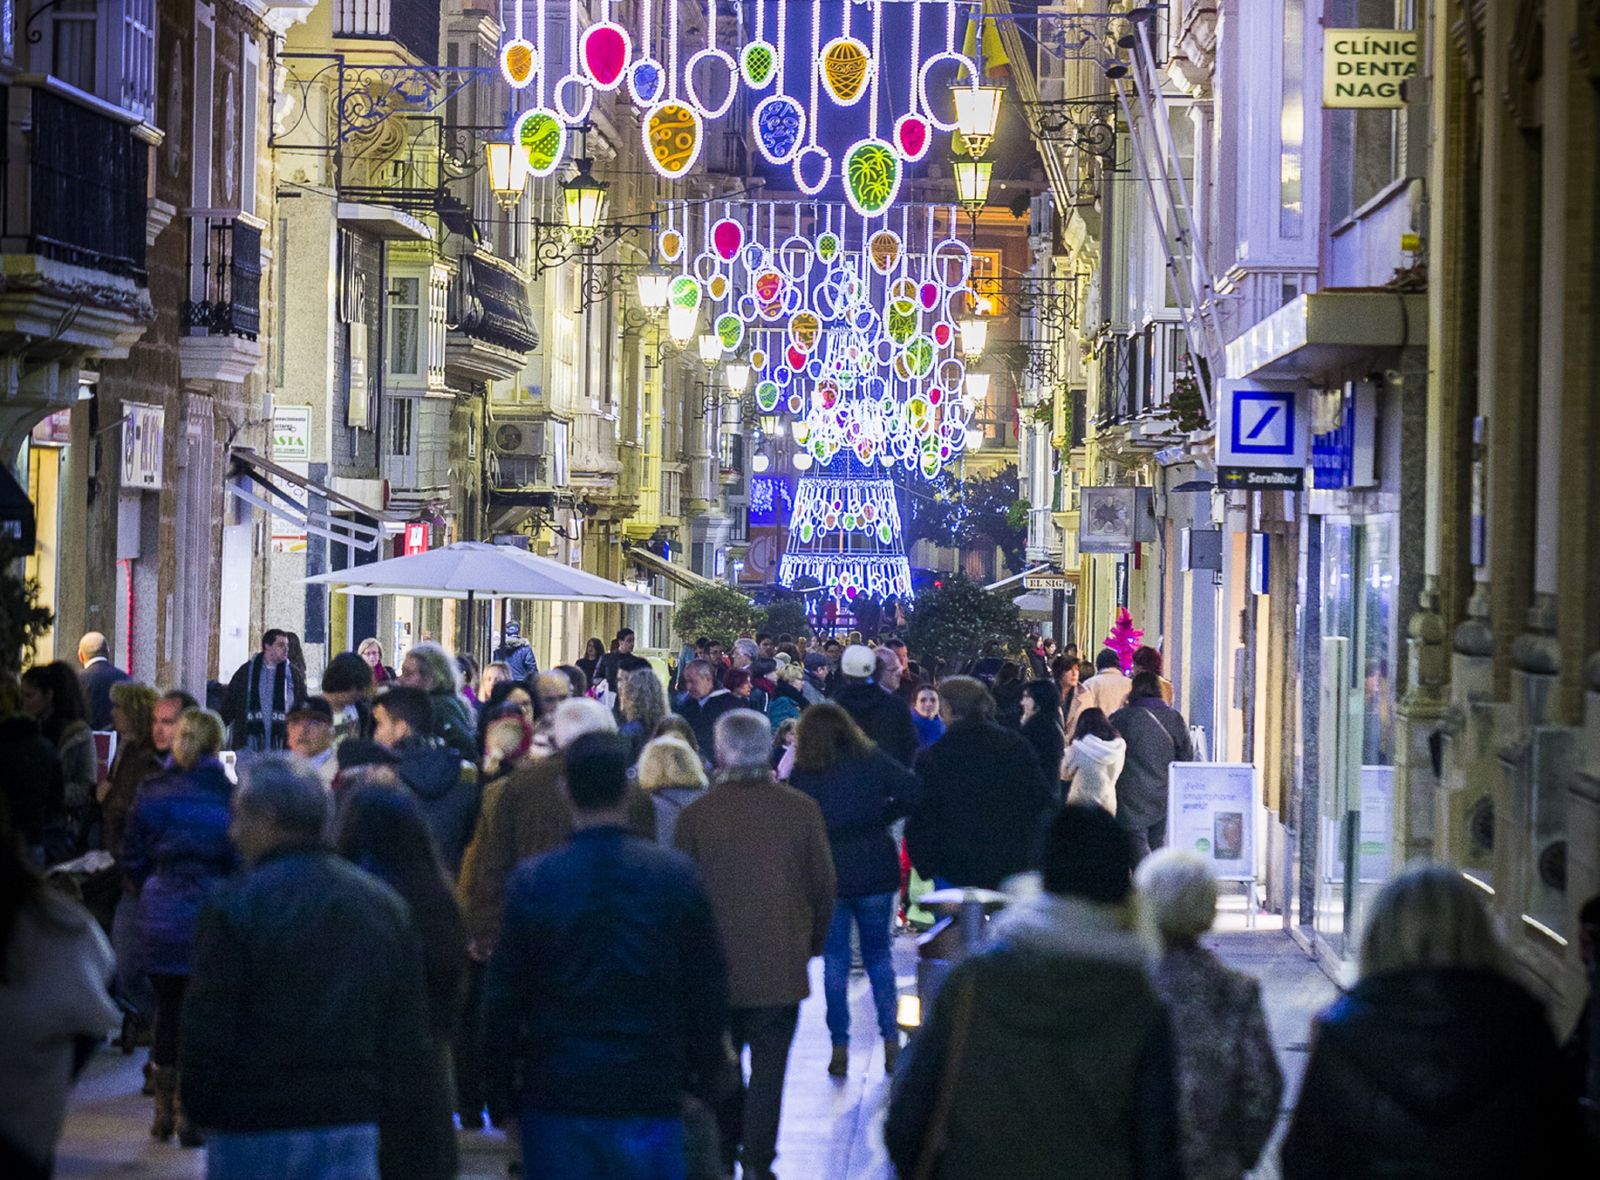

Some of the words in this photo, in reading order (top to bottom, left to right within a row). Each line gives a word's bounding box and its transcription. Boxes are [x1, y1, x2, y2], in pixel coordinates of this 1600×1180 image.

[1334, 36, 1417, 55] CLÍNIC
[1337, 62, 1417, 76] DENTA
[1336, 83, 1401, 98] NAG
